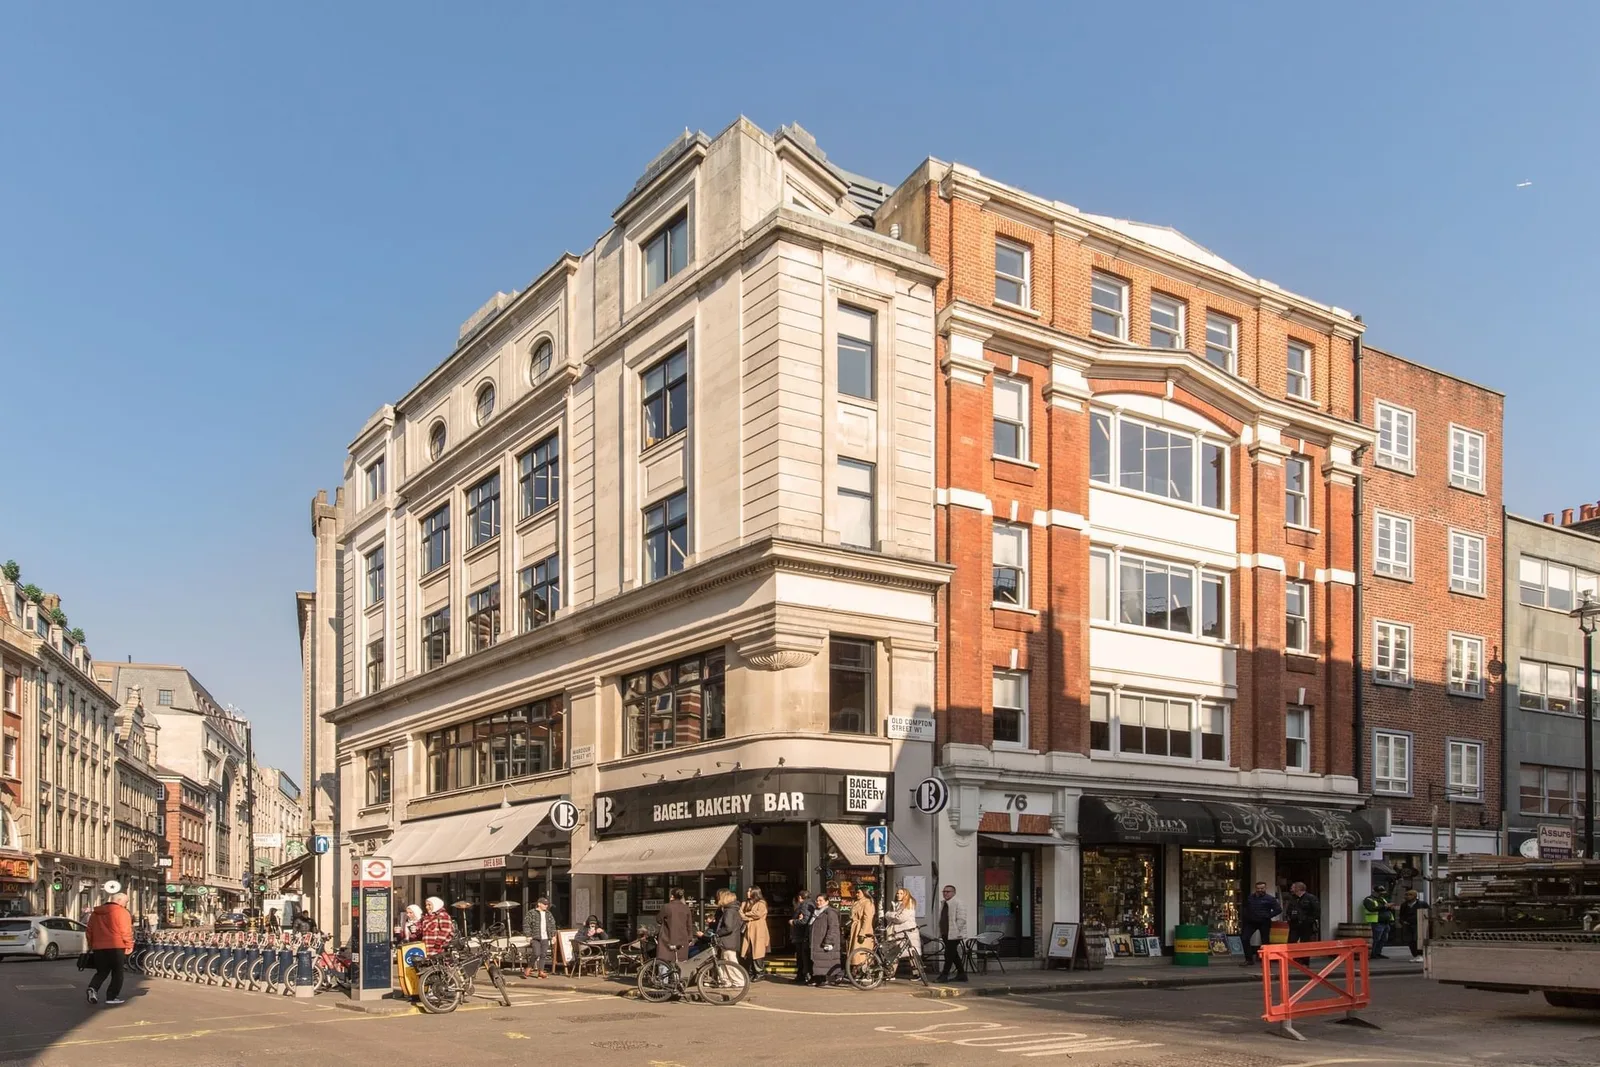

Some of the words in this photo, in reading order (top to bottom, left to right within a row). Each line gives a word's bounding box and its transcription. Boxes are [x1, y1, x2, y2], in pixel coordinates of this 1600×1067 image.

[891, 717, 903, 725] OLD
[905, 718, 933, 727] COMPTON
[891, 724, 913, 732] STREET
[849, 778, 878, 789] BAGEL
[849, 788, 885, 800] BAKERY
[653, 801, 692, 822] BAGEL
[696, 794, 752, 818] BAKERY
[764, 791, 805, 812] BAR
[849, 799, 867, 809] BAR
[1004, 793, 1028, 812] 76
[596, 796, 613, 829] B
[1541, 827, 1571, 838] Assure
